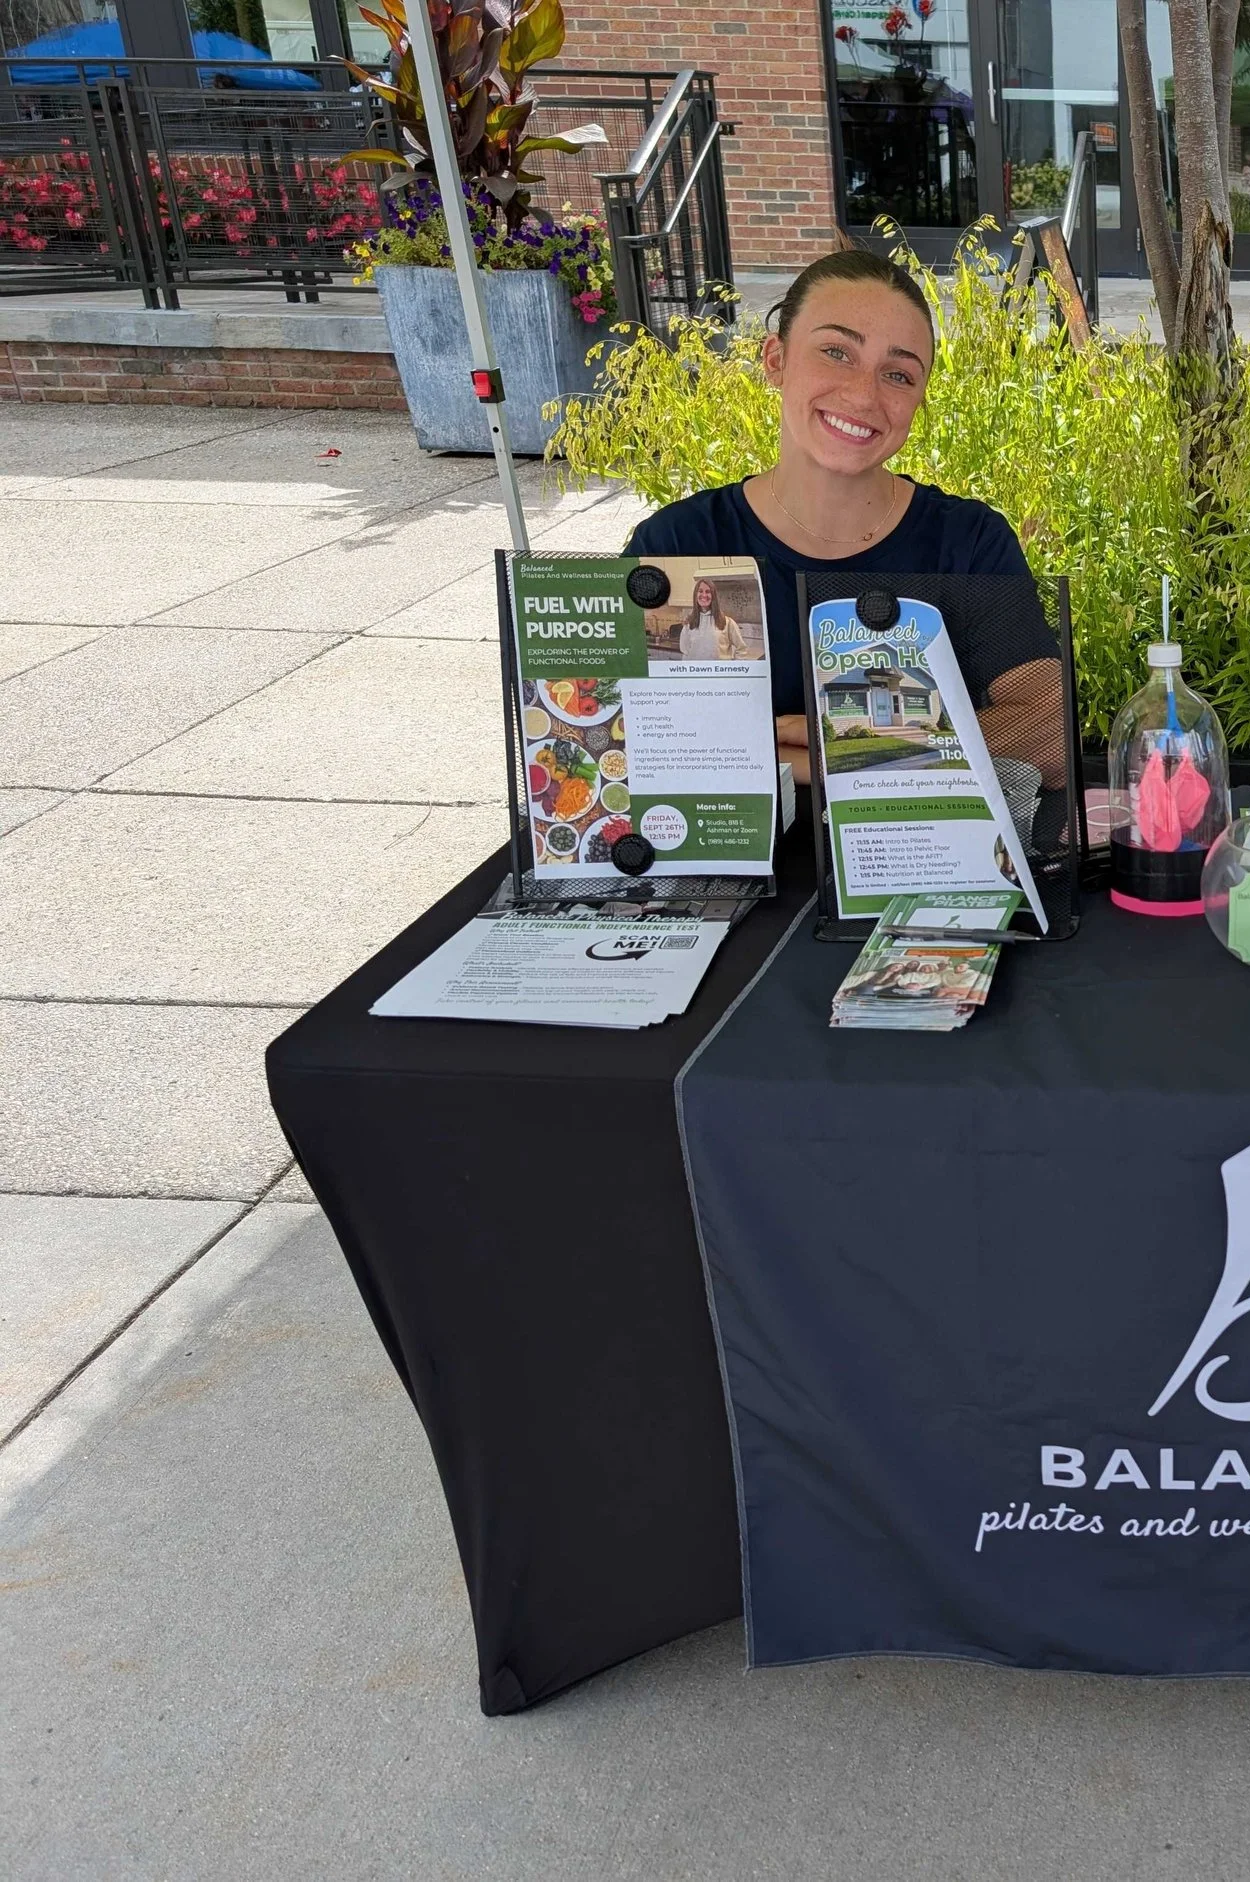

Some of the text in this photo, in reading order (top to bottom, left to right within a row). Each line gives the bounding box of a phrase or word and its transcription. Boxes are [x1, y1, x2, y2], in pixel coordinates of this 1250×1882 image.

[521, 564, 554, 573] Balanced
[524, 597, 624, 614] FUEL WITH
[526, 622, 617, 639] PURPOSE
[819, 618, 919, 650] Balanced
[818, 651, 891, 675] Open
[715, 666, 750, 674] Earnesty
[853, 780, 875, 790] Come
[878, 779, 899, 787] check
[916, 781, 934, 790] your
[929, 861, 961, 869] Needling?
[500, 912, 705, 924] Balanced Physical Therapy
[613, 941, 658, 949] ME!
[974, 1503, 1104, 1552] pilates
[1120, 1508, 1200, 1539] and
